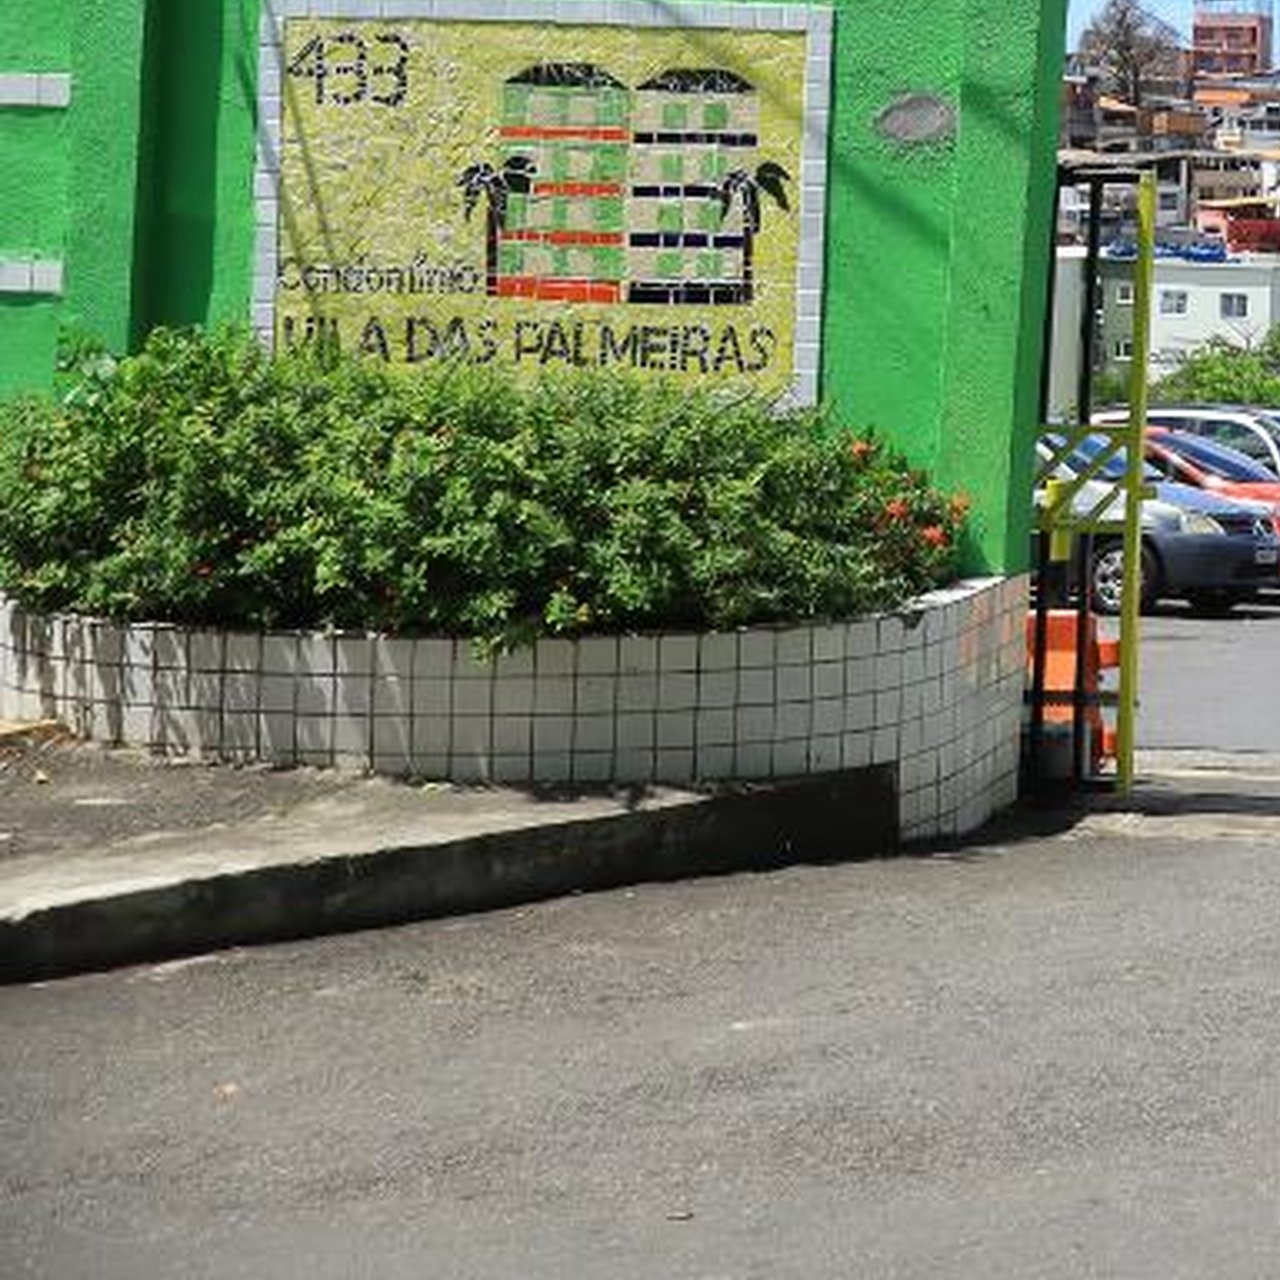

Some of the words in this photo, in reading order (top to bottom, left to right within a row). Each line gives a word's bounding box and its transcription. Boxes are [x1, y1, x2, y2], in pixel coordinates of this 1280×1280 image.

[286, 34, 408, 106] 433
[284, 316, 390, 365] VA
[405, 316, 498, 365] DAS
[514, 321, 777, 373] PALMEIRAS
